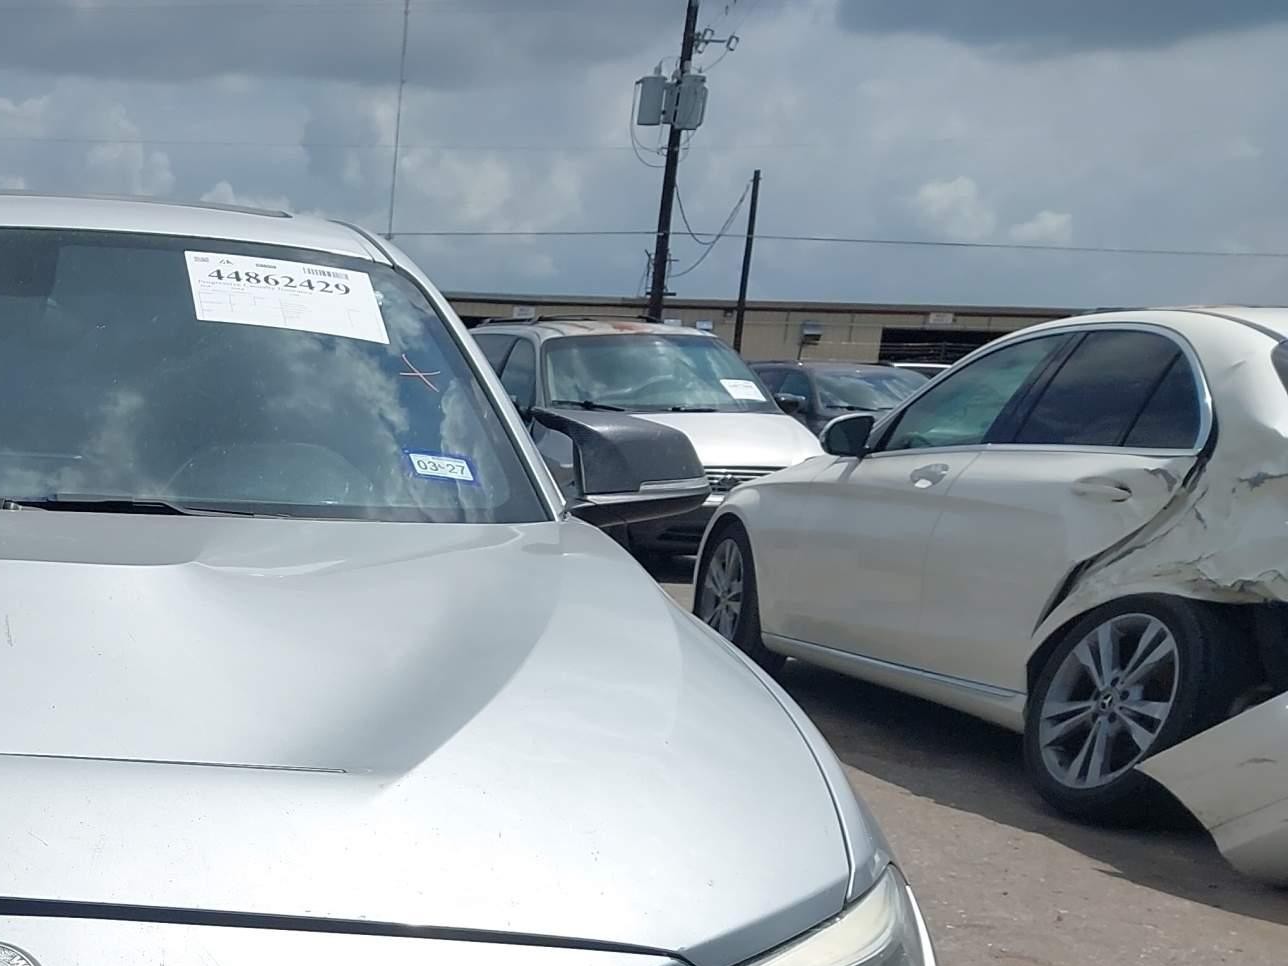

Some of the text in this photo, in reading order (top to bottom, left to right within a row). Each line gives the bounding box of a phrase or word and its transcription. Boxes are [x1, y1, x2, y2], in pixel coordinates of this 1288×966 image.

[207, 268, 351, 297] 44862429
[416, 459, 440, 472] 03
[446, 463, 466, 475] 27
